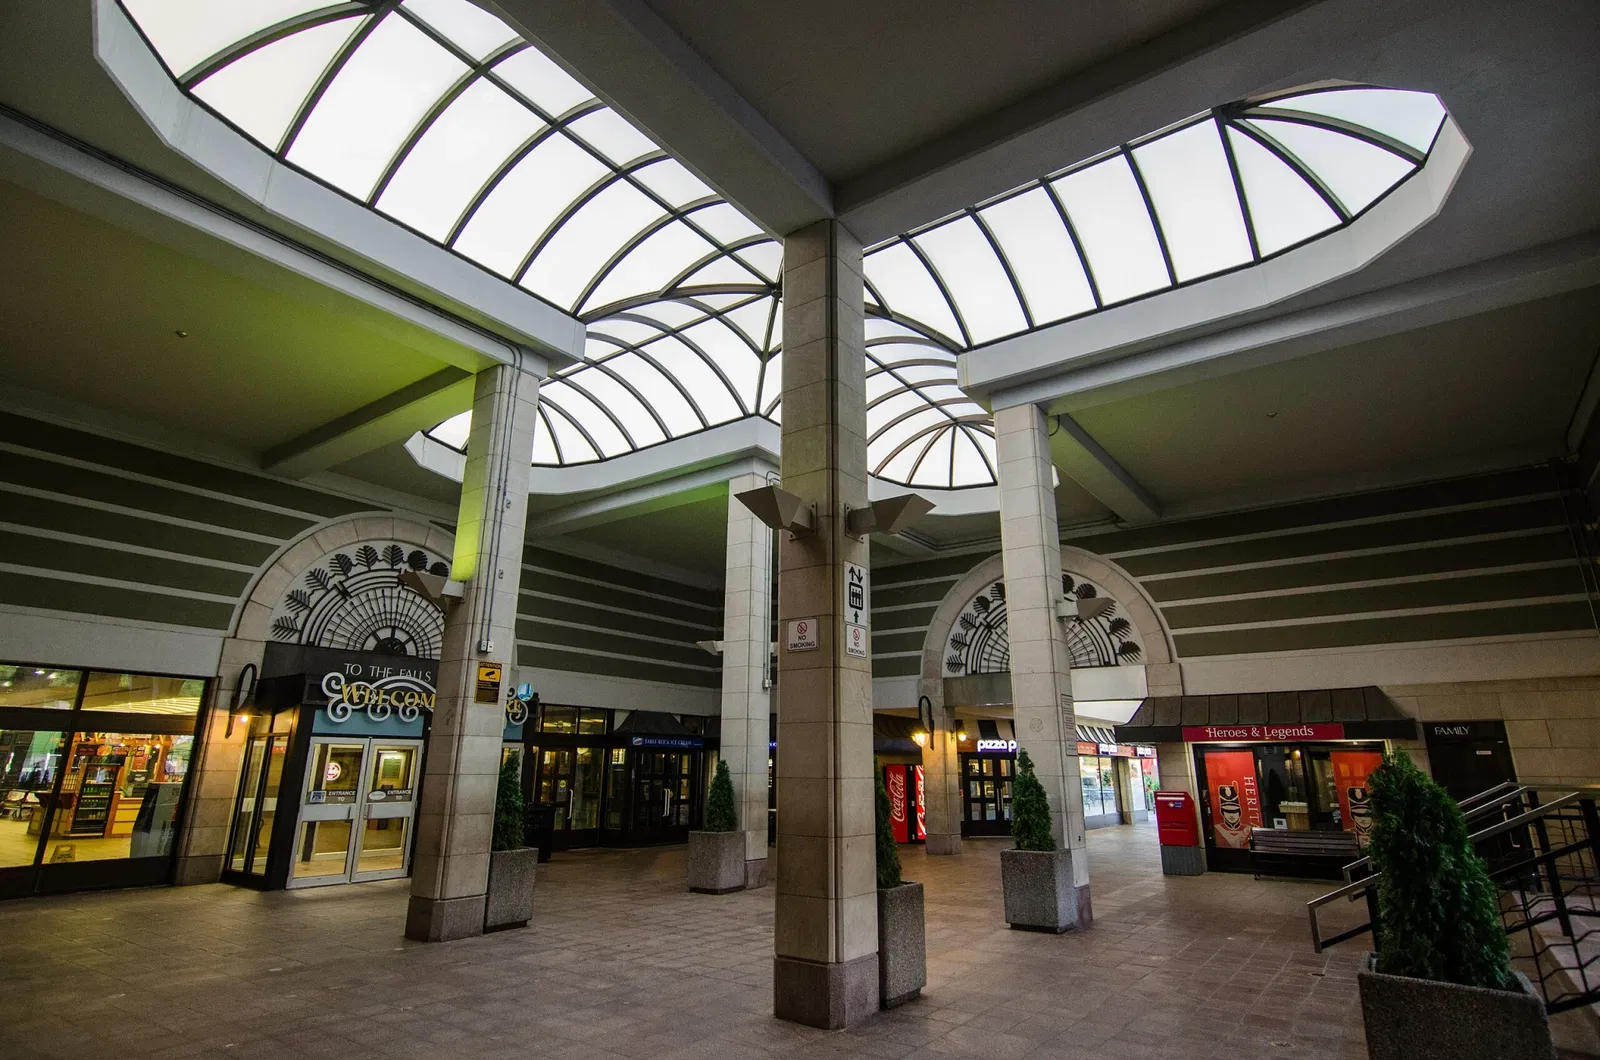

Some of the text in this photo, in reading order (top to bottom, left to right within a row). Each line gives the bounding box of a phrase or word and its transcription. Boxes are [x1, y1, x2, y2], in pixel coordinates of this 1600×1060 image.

[790, 641, 815, 649] SMOKING
[848, 647, 865, 656] SMOKING
[344, 663, 432, 682] TO THE FALLS
[341, 683, 437, 709] WELCOM
[1207, 725, 1314, 739] Heroes & Legends
[1434, 726, 1470, 736] FAMILY
[977, 740, 1007, 752] pizza
